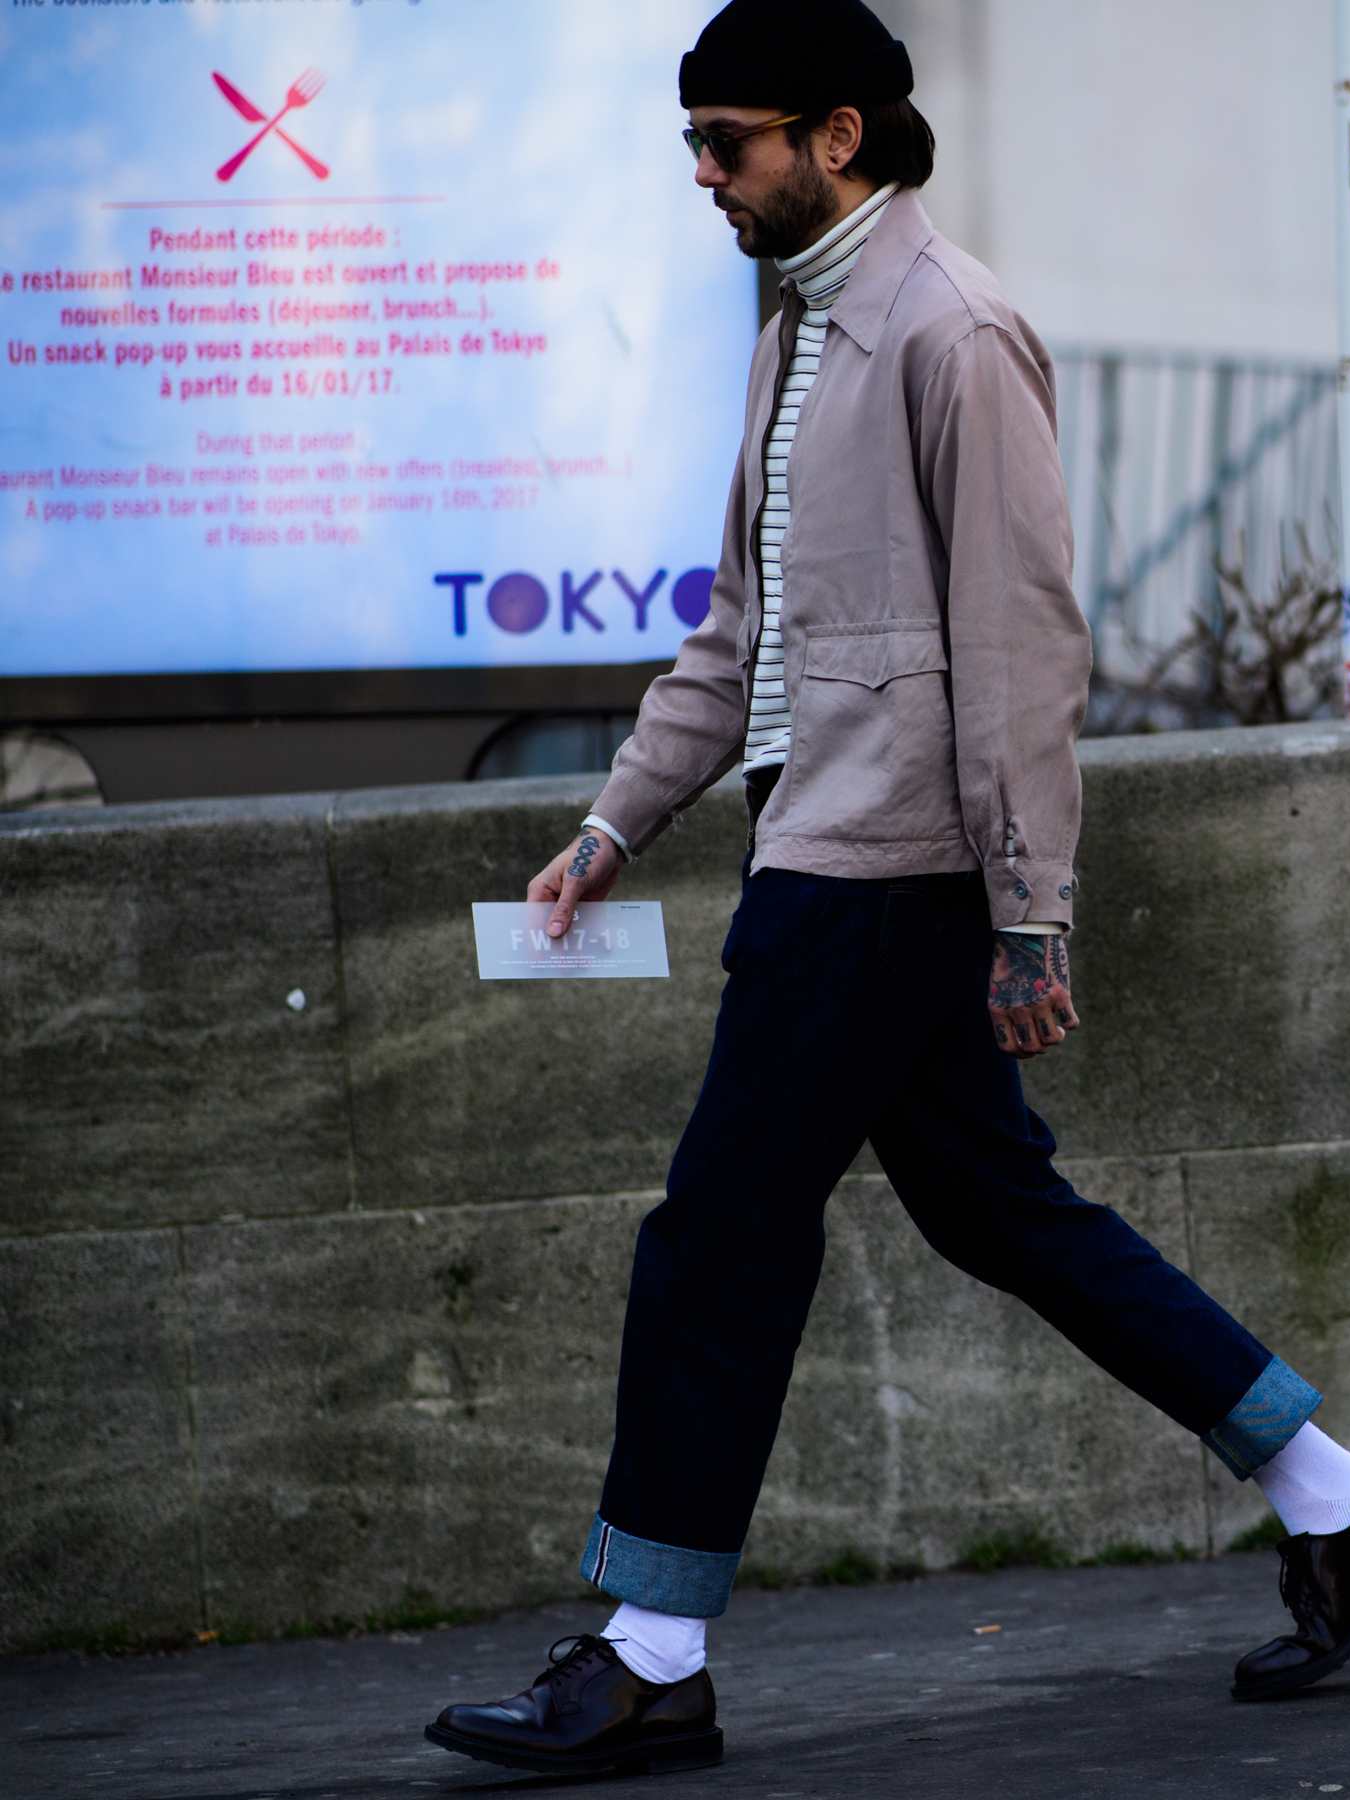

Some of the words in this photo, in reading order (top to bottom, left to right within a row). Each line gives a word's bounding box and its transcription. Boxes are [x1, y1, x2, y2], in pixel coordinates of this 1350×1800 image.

[150, 227, 237, 251] Pendant
[245, 227, 299, 250] cette
[308, 224, 386, 252] période
[0, 270, 14, 291] e
[22, 267, 133, 291] restaurant
[140, 264, 239, 289] Monsieur
[247, 262, 294, 287] Bleu
[303, 262, 334, 285] est
[343, 260, 408, 285] ouvert
[416, 260, 437, 284] et
[445, 261, 527, 286] propose
[535, 256, 560, 280] de
[61, 301, 160, 327] nouvelles
[168, 299, 260, 325] formules
[268, 297, 377, 329] (déjeuner,
[8, 340, 37, 365] Un
[44, 338, 106, 364] snack
[115, 342, 188, 369] pop-up
[196, 341, 242, 360] vous
[251, 334, 346, 358] accueille
[356, 337, 380, 357] au
[389, 331, 452, 357] Palais
[460, 330, 484, 356] de
[490, 329, 548, 359] Tokyo
[160, 371, 173, 398] à
[180, 374, 240, 402] partir
[247, 373, 273, 397] du
[283, 368, 401, 400] 16/01/17.
[196, 430, 253, 459] During
[259, 431, 293, 453] that
[60, 464, 140, 489] Monsieur
[146, 462, 185, 487] Bleu
[191, 464, 260, 486] remains
[266, 464, 309, 486] open
[25, 498, 38, 520] A
[43, 500, 106, 524] pop-up
[112, 496, 162, 519] snack
[168, 496, 196, 518] bar
[228, 523, 280, 547] Palais
[435, 567, 717, 636] TOKYO
